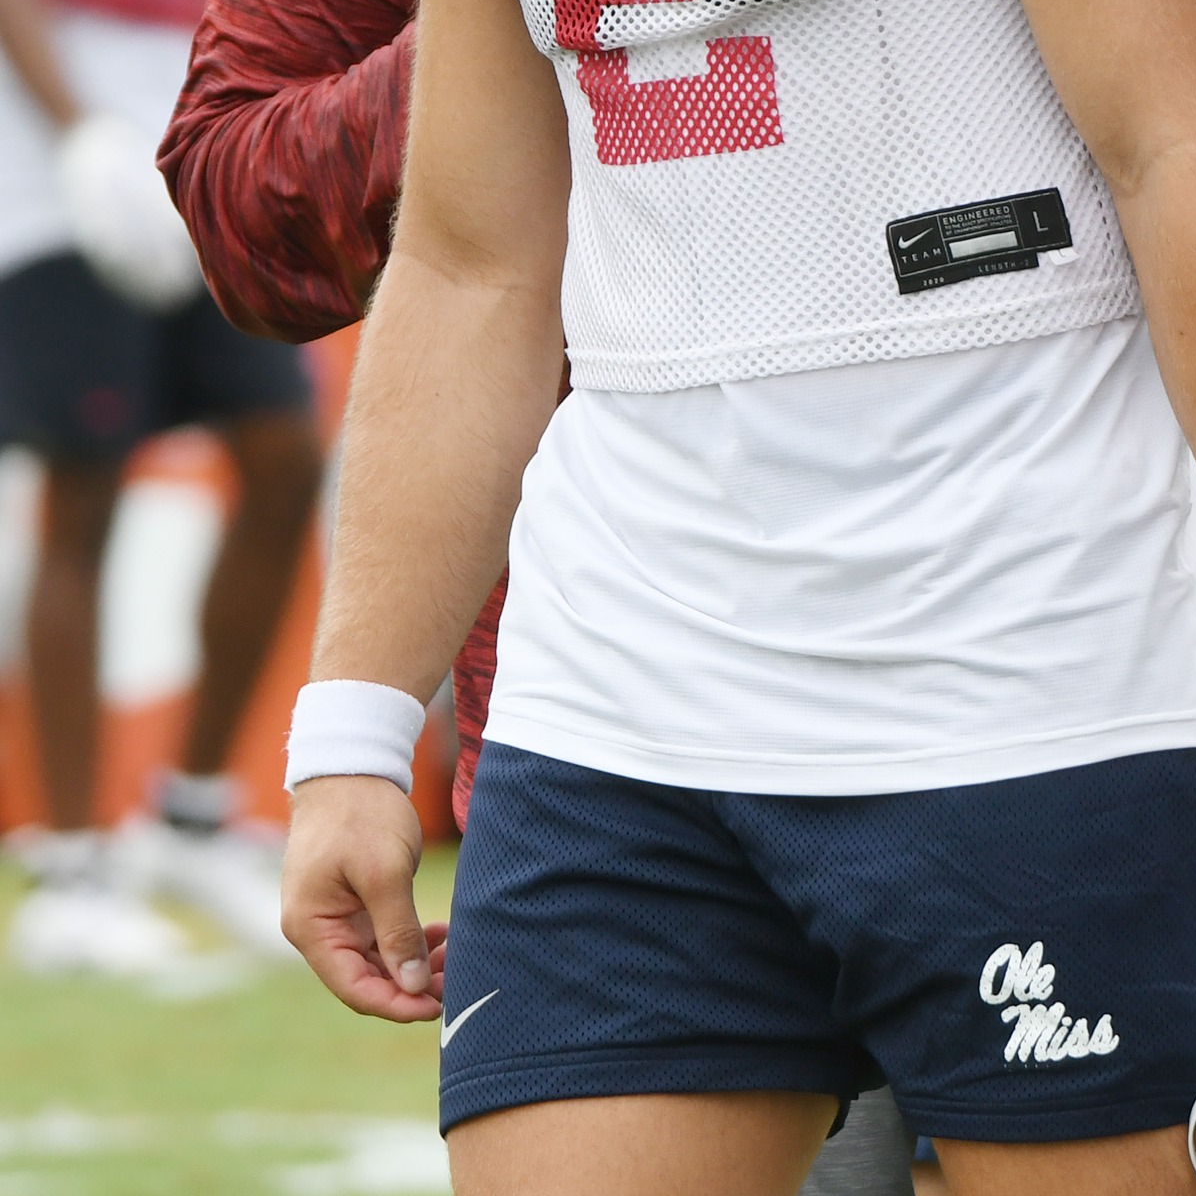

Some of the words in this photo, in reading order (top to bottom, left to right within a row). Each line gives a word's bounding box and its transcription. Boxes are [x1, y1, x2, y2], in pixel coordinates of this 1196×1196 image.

[942, 205, 1010, 225] ENGINEERED
[1032, 210, 1049, 232] L
[901, 247, 942, 264] TEAM
[977, 260, 1017, 273] LENGTH
[922, 276, 945, 287] 2020
[979, 940, 1056, 1005] Ole
[1001, 1001, 1120, 1062] Miss
